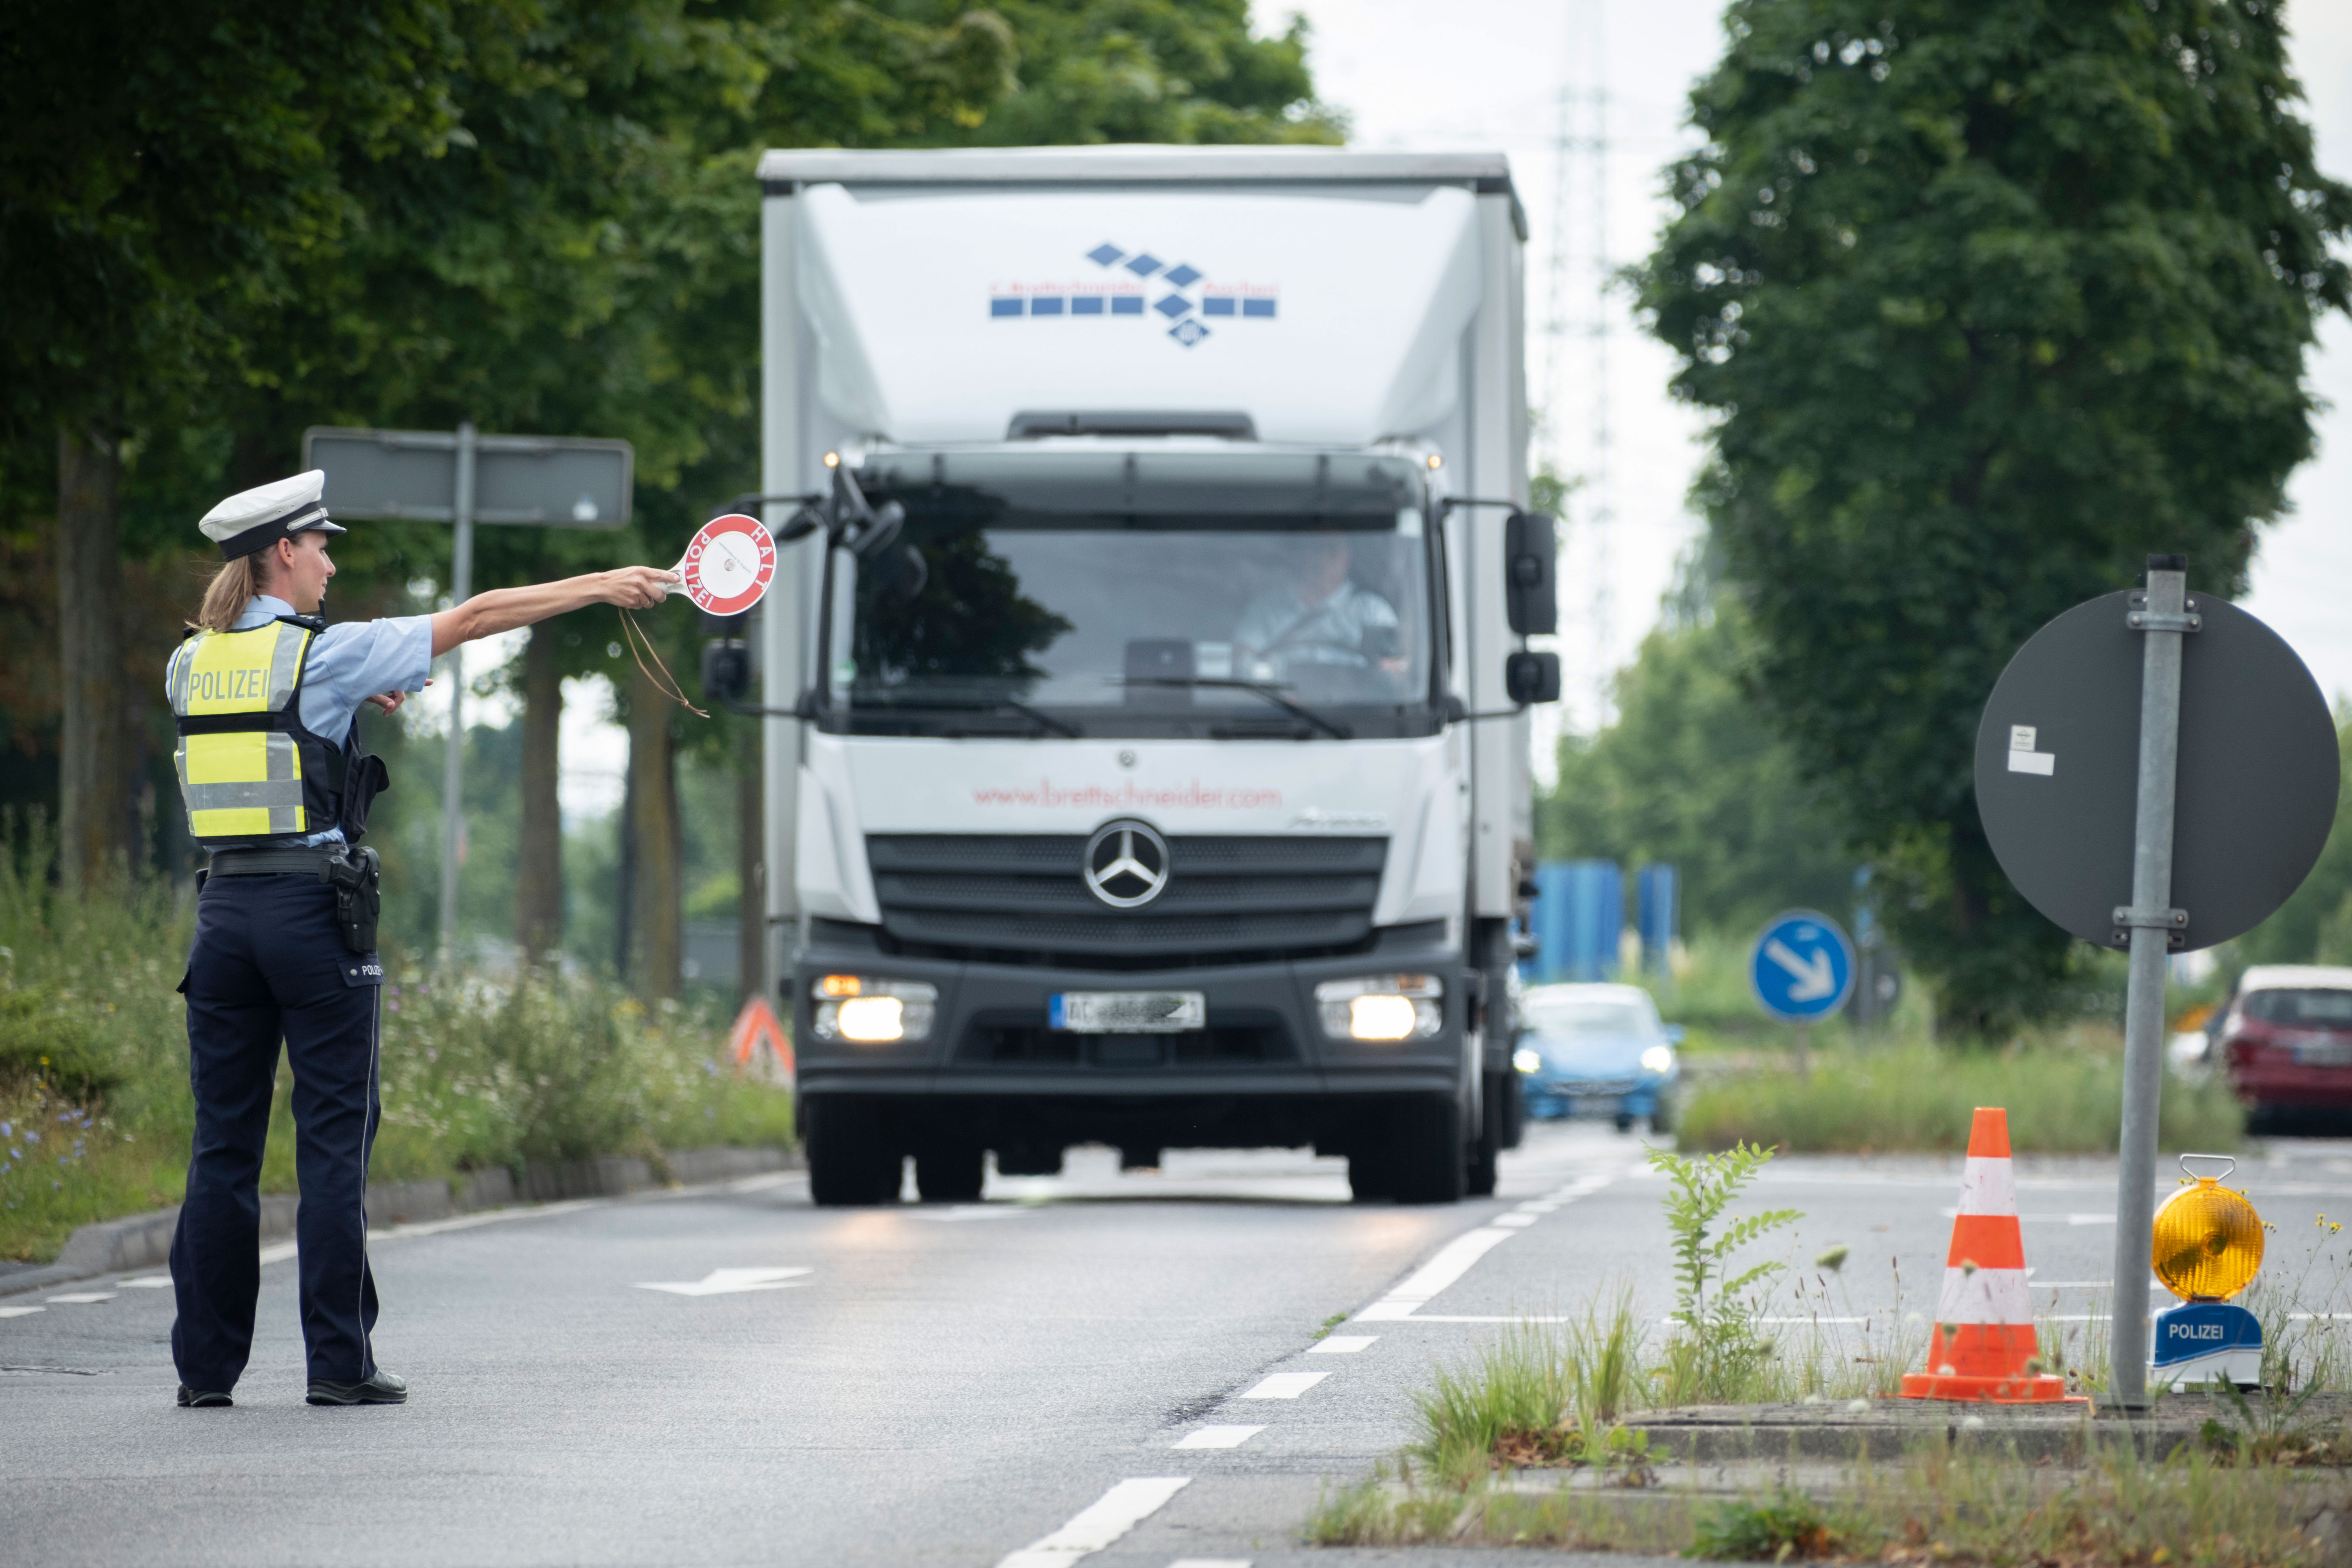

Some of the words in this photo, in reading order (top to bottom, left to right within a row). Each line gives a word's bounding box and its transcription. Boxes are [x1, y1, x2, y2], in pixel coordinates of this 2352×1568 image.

[686, 531, 714, 609] POLIZEI
[751, 526, 773, 590] HALT
[189, 669, 269, 702] POLIZEI
[972, 777, 1283, 809] www.brettschneider.com
[2169, 1323, 2223, 1339] POLIZEI
